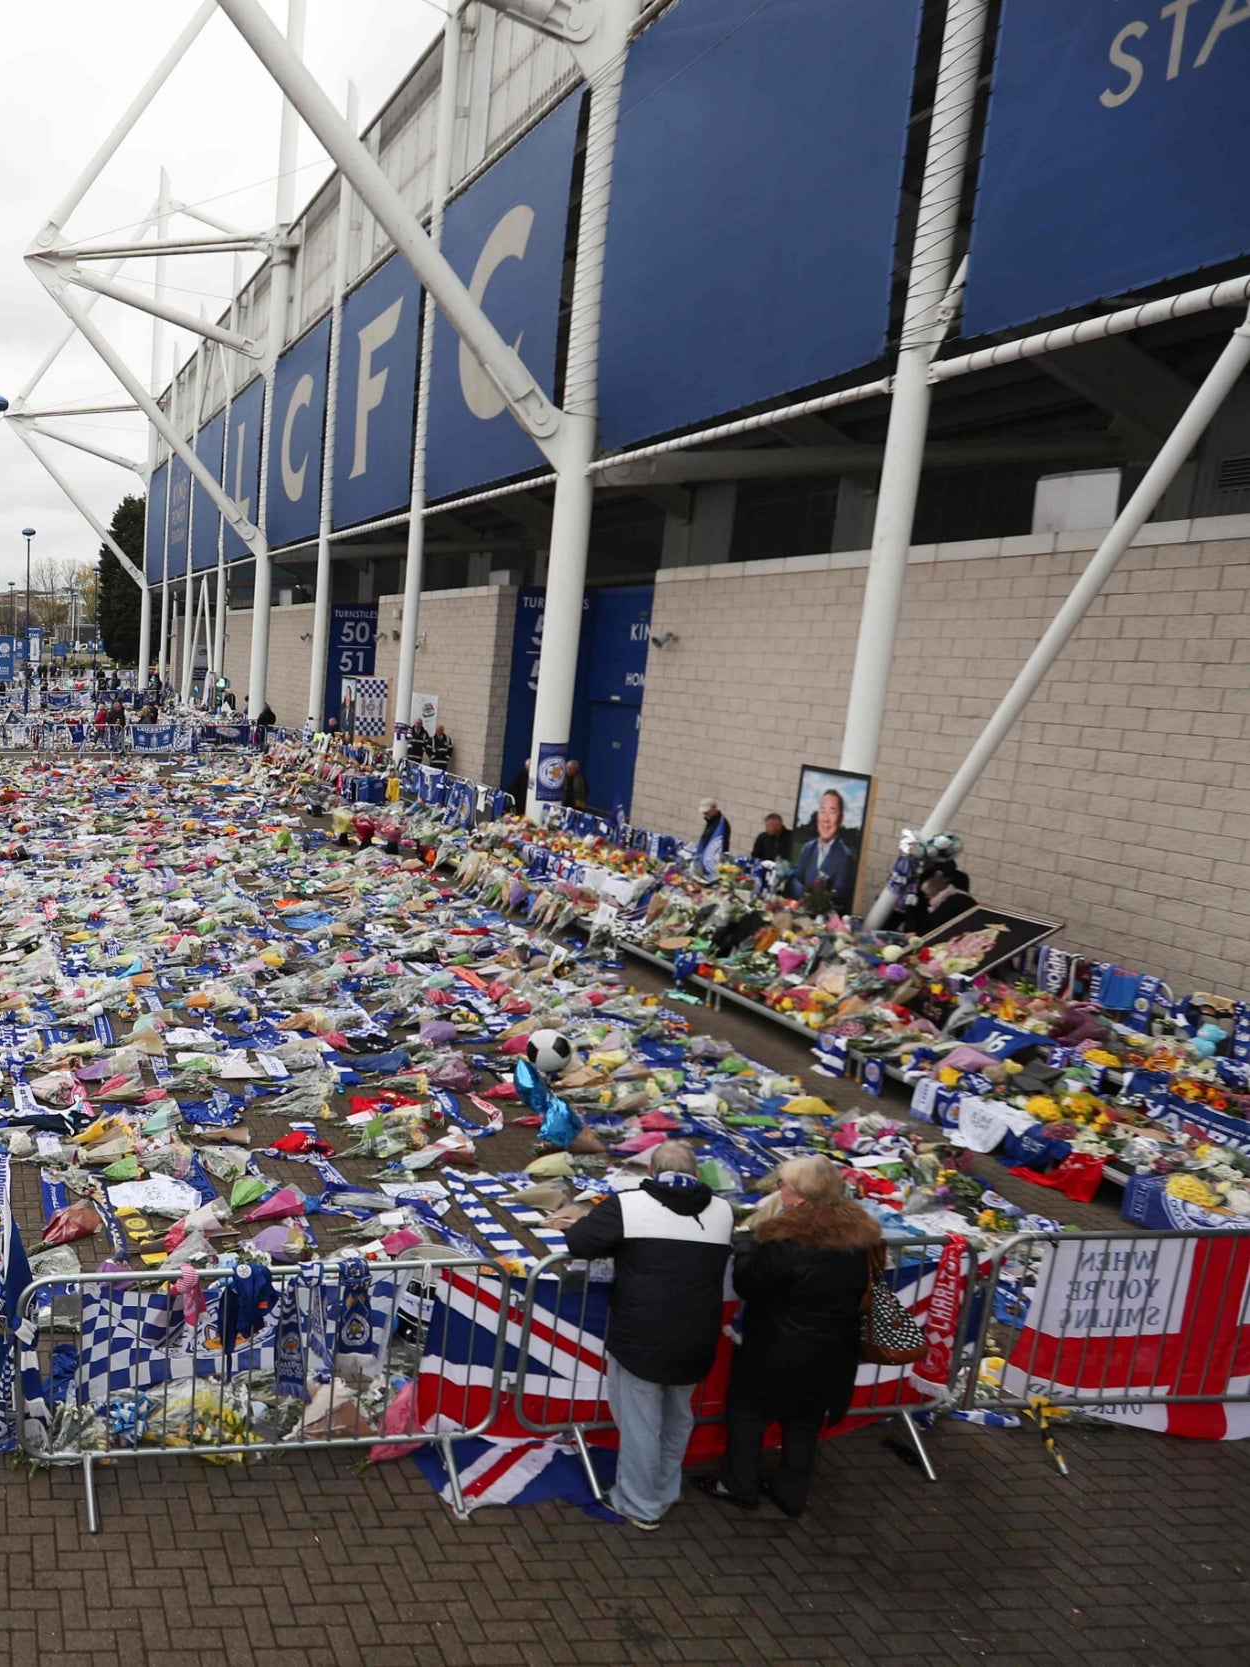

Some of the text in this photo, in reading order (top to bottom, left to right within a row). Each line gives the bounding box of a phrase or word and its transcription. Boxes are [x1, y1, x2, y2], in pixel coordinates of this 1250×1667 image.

[234, 204, 536, 518] LCFC
[335, 609, 378, 618] TURNSTILES
[340, 621, 370, 643] 50
[630, 623, 651, 640] KIN
[338, 651, 365, 672] 51
[982, 1031, 1013, 1053] 16
